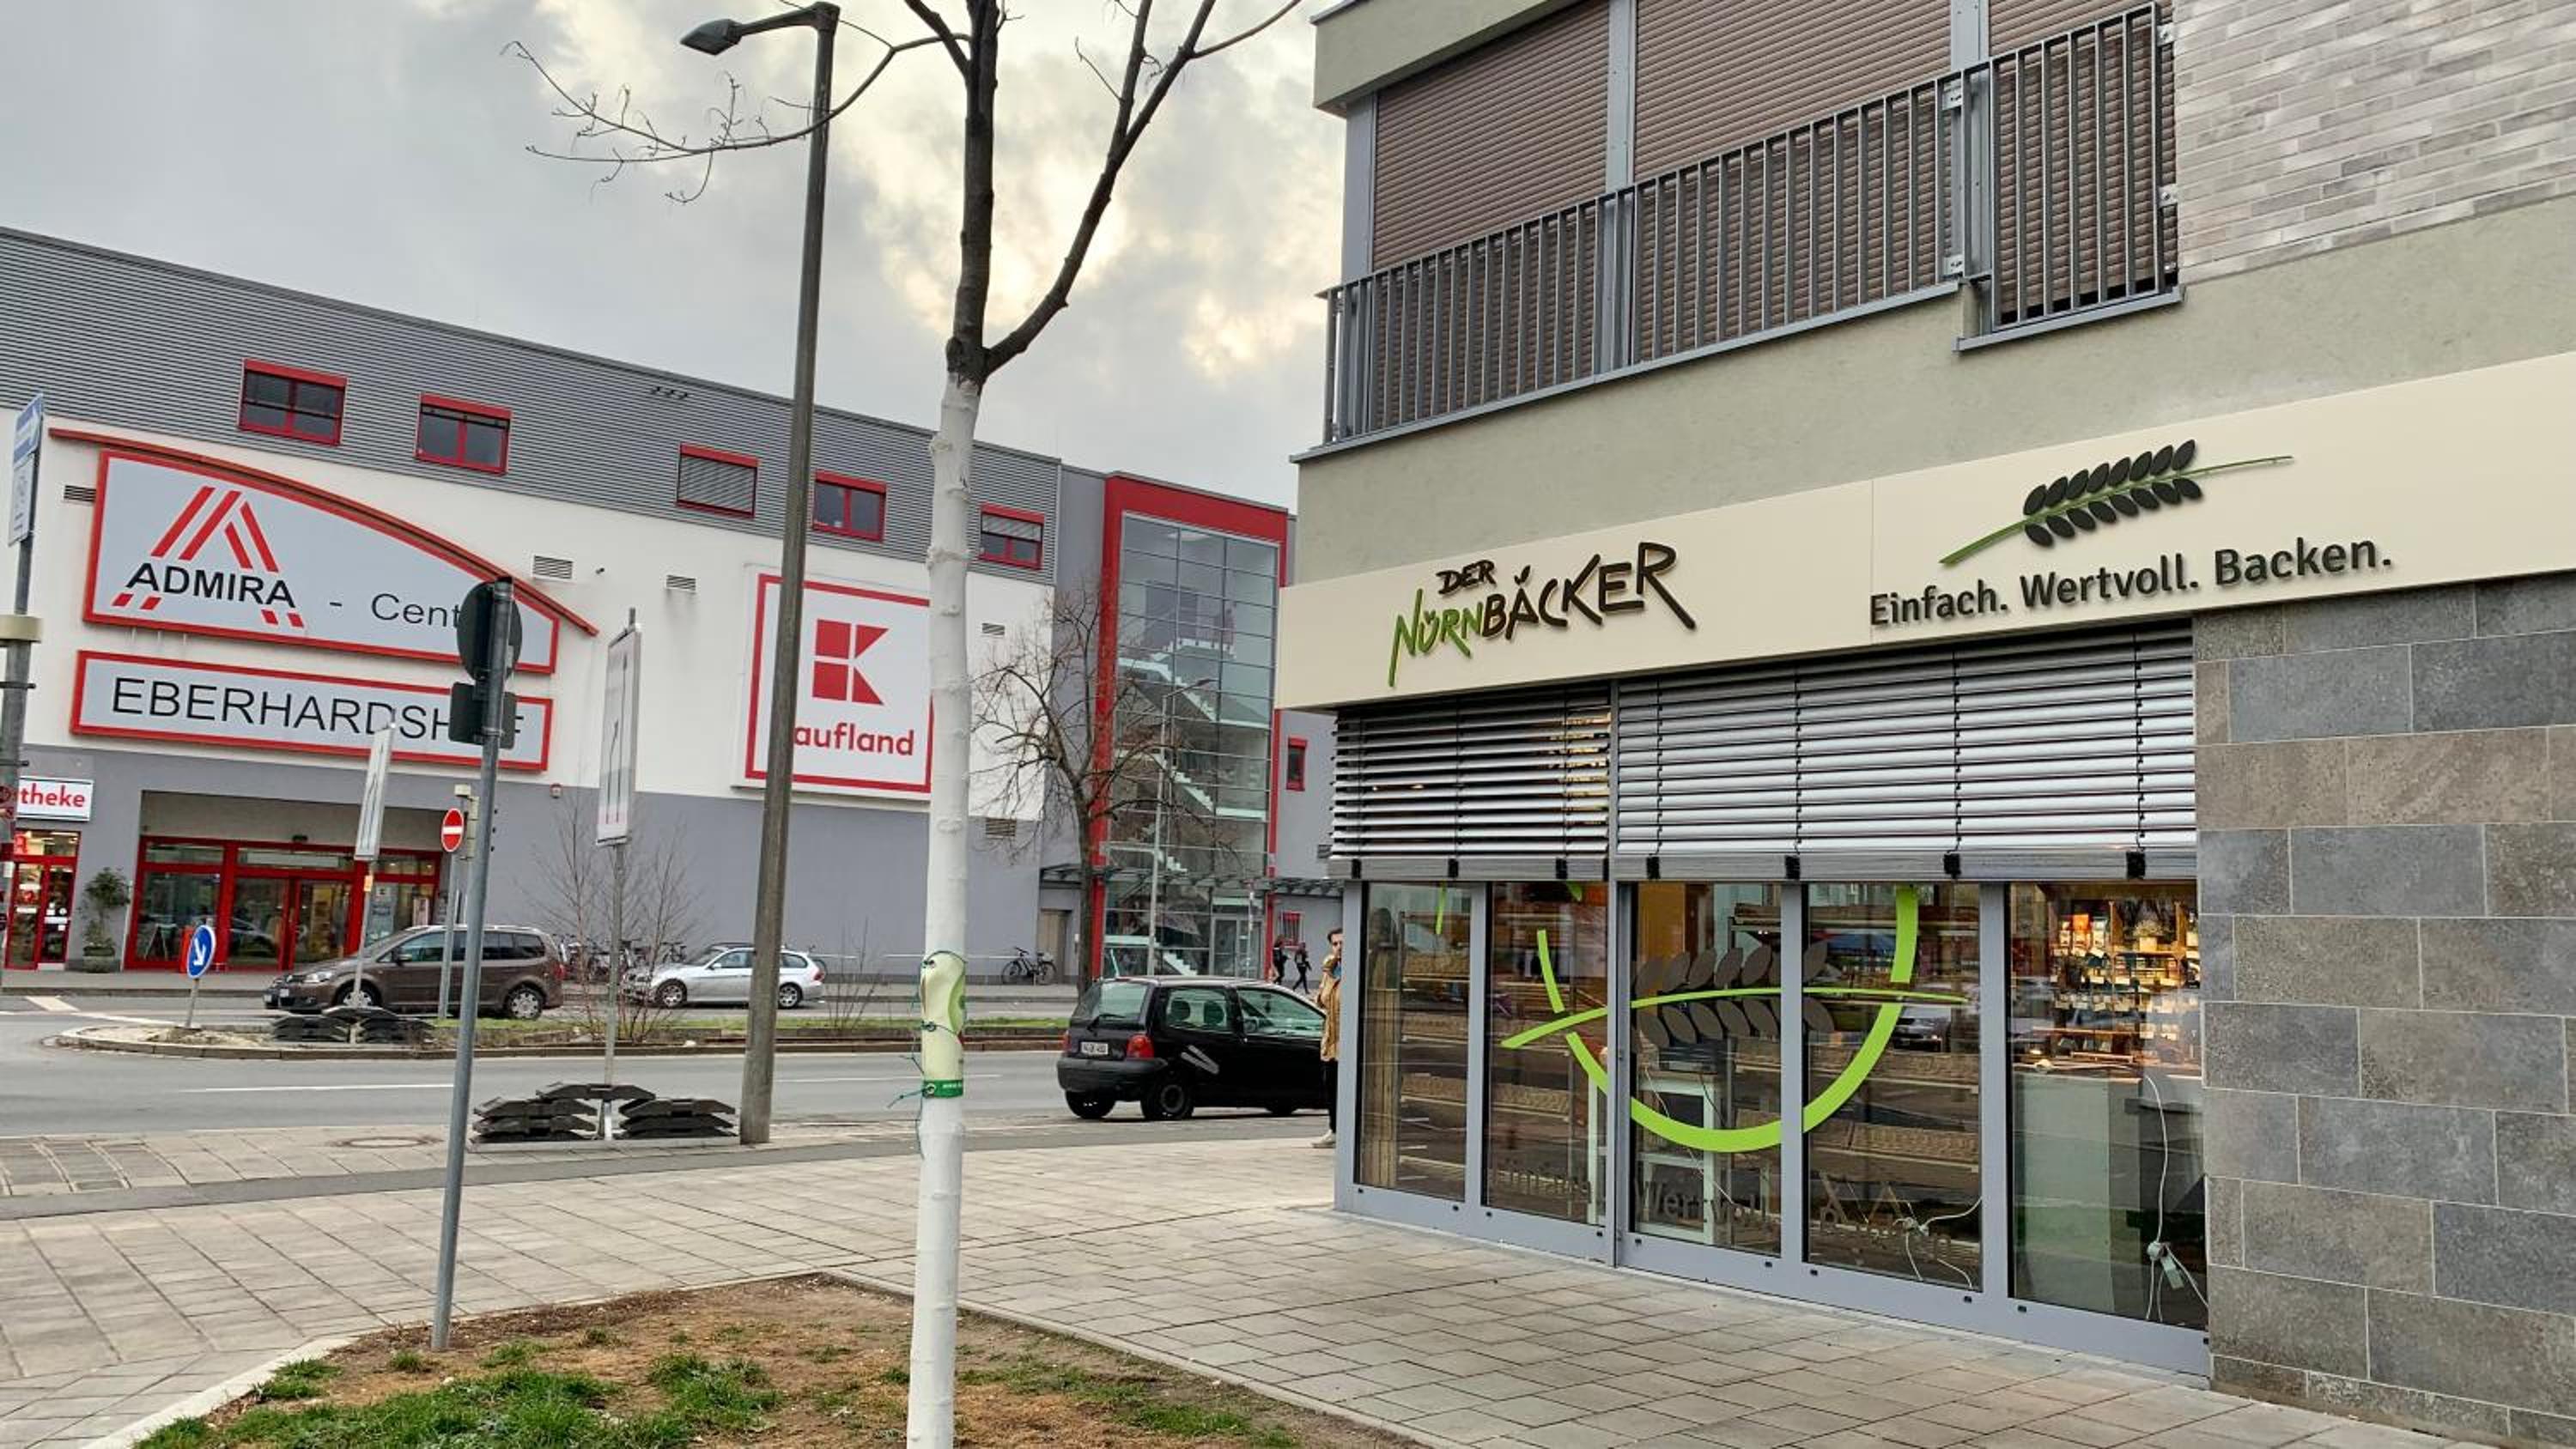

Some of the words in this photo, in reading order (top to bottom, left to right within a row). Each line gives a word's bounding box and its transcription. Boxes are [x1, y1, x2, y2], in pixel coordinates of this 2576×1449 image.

[125, 562, 296, 609] ADMIRA
[371, 592, 461, 629] Cent
[1435, 559, 1497, 595] DER
[1869, 579, 2008, 626] Einfach.
[2020, 552, 2199, 609] Wertvoll.
[2215, 537, 2392, 586] Backen.
[1388, 547, 1696, 688] NÜRNBÄCKER
[112, 676, 524, 740] EBERHARDSH
[794, 722, 914, 756] aufland
[20, 782, 87, 808] theke
